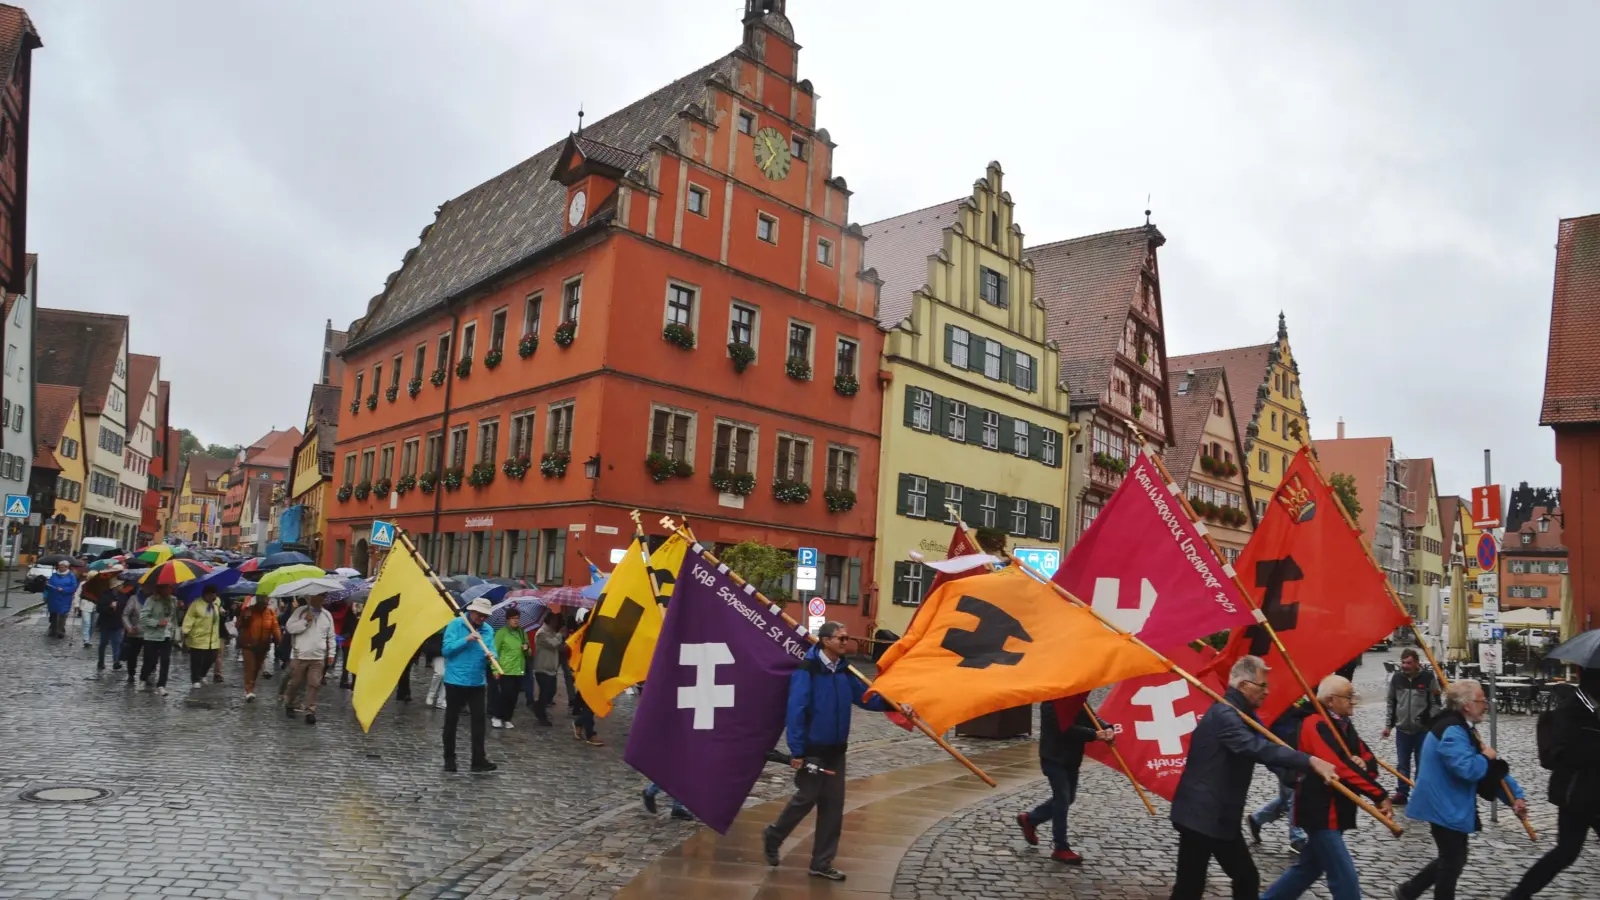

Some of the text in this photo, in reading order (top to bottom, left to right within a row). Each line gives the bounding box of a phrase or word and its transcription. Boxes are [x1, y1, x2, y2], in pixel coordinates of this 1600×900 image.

[802, 550, 813, 564] P
[1179, 537, 1222, 589] LITZENDORF
[691, 563, 807, 661] KAB Schesslitz St Kilia
